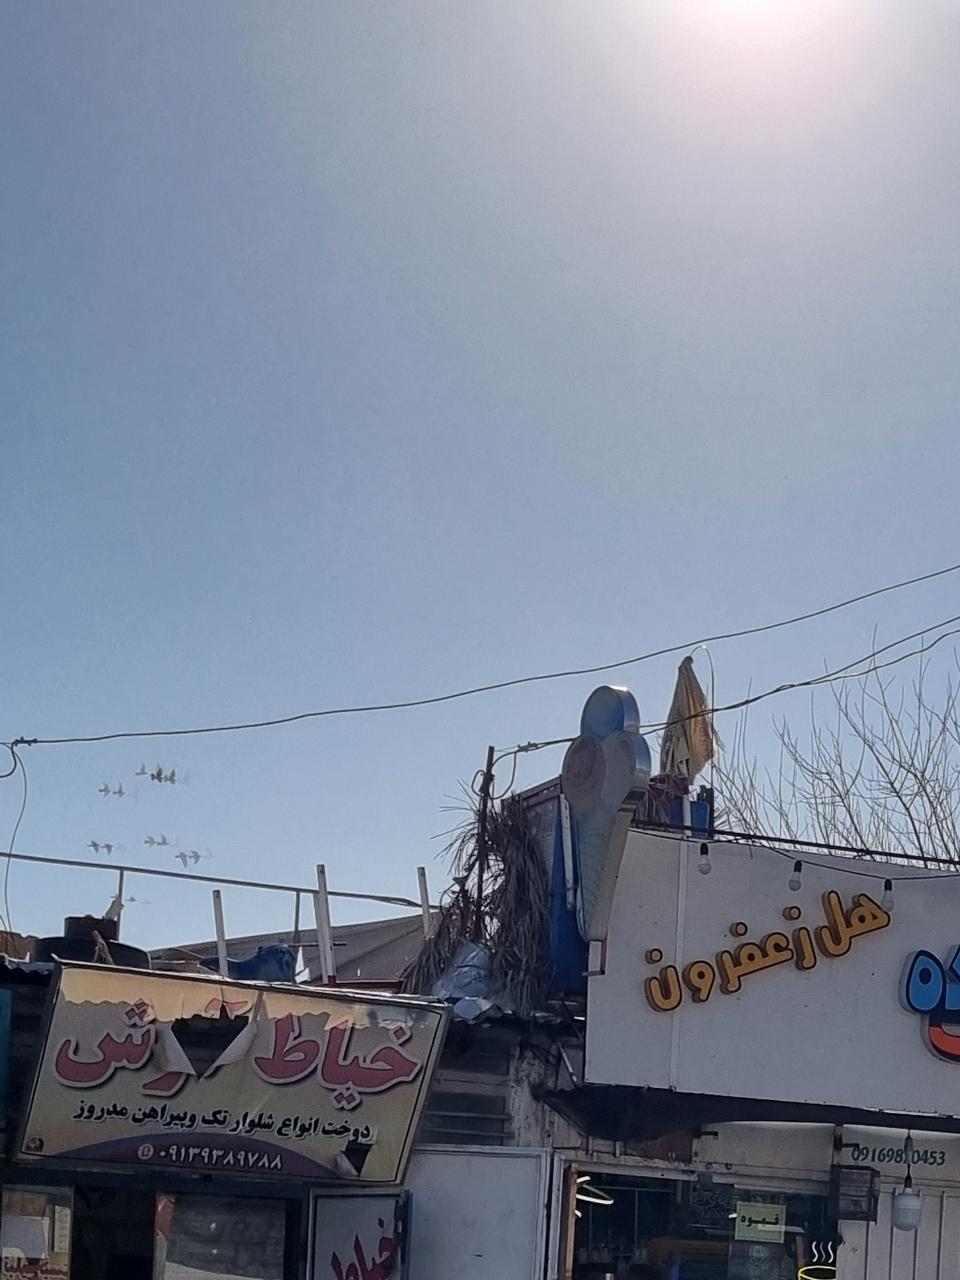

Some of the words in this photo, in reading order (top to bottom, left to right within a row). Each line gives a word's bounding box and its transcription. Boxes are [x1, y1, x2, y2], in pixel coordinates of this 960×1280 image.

[814, 889, 891, 958] هل
[253, 1014, 423, 1110] خیاط
[201, 1109, 229, 1126] تک
[230, 1112, 274, 1134] شلوار
[276, 1116, 319, 1137] انواع
[321, 1118, 371, 1141] دوخت
[851, 1146, 946, 1166] 0916980453
[740, 1213, 779, 1227] قهوه
